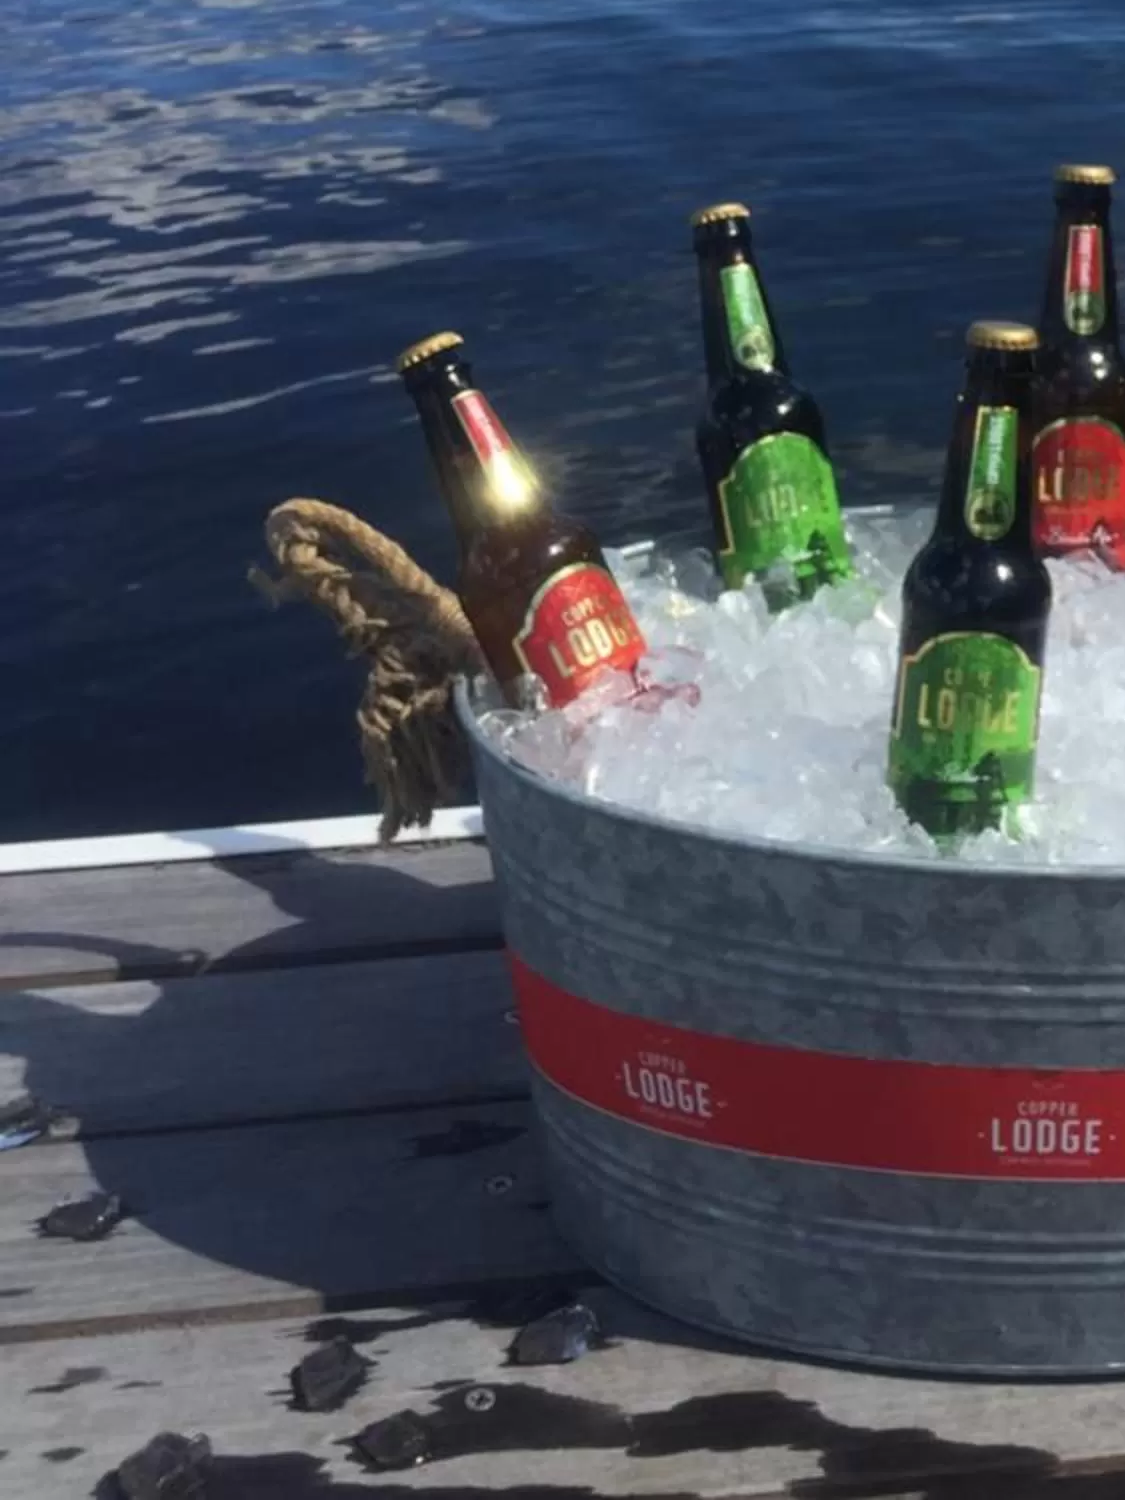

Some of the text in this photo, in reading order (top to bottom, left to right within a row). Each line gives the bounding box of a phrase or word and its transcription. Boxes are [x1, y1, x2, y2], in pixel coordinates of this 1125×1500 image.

[622, 1060, 714, 1118] LODGE
[1016, 1100, 1079, 1117] COPPER
[990, 1117, 1103, 1157] LODGE
